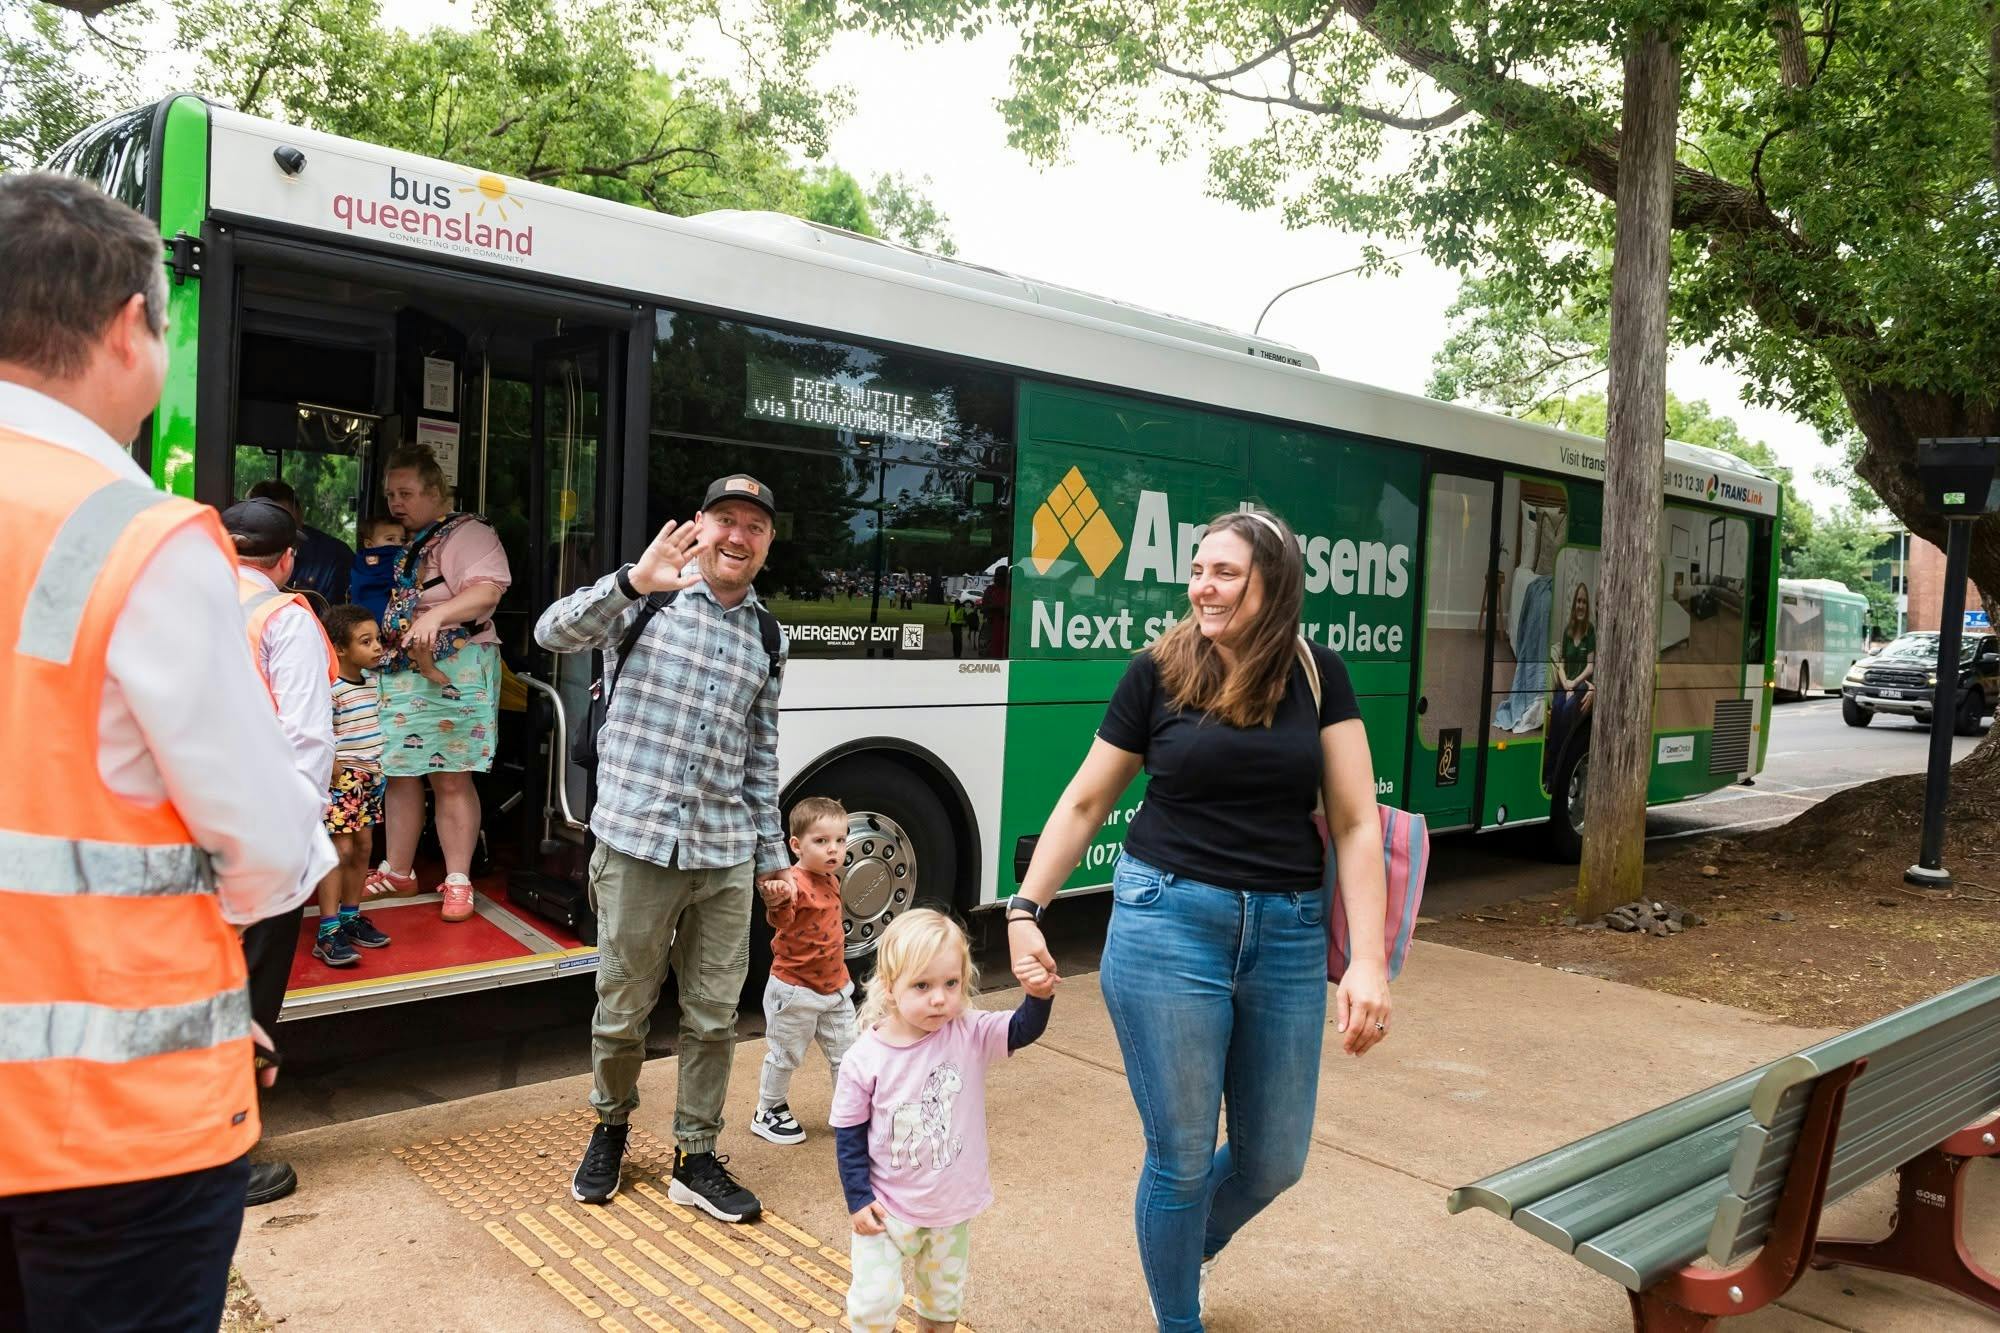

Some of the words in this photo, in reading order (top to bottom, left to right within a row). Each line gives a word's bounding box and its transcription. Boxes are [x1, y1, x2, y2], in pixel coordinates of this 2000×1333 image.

[390, 166, 451, 209] bus
[333, 194, 533, 256] queensland
[389, 231, 449, 249] CONNECTING
[451, 244, 471, 253] OUR
[473, 248, 526, 263] COMMUNITY
[1260, 350, 1286, 363] THERMO
[1287, 358, 1301, 367] KING
[793, 377, 836, 403] FREE
[840, 386, 913, 415] SHUTTLE
[754, 395, 786, 418] via
[791, 398, 889, 432] TOOWOOMBA
[892, 415, 942, 441] PLAZA
[1560, 446, 1580, 466] Visit
[1674, 473, 1683, 489] 13
[1685, 475, 1694, 491] 12
[1695, 478, 1705, 494] 30
[1721, 483, 1763, 506] TRANSLink
[1124, 489, 1409, 598] Ansens
[780, 625, 868, 641] EMERGENCY
[870, 626, 899, 642] EXIT
[1030, 600, 1134, 649] Next
[1327, 611, 1403, 653] place
[958, 663, 1000, 674] SCANIA
[1915, 1189, 1946, 1203] GOSSI
